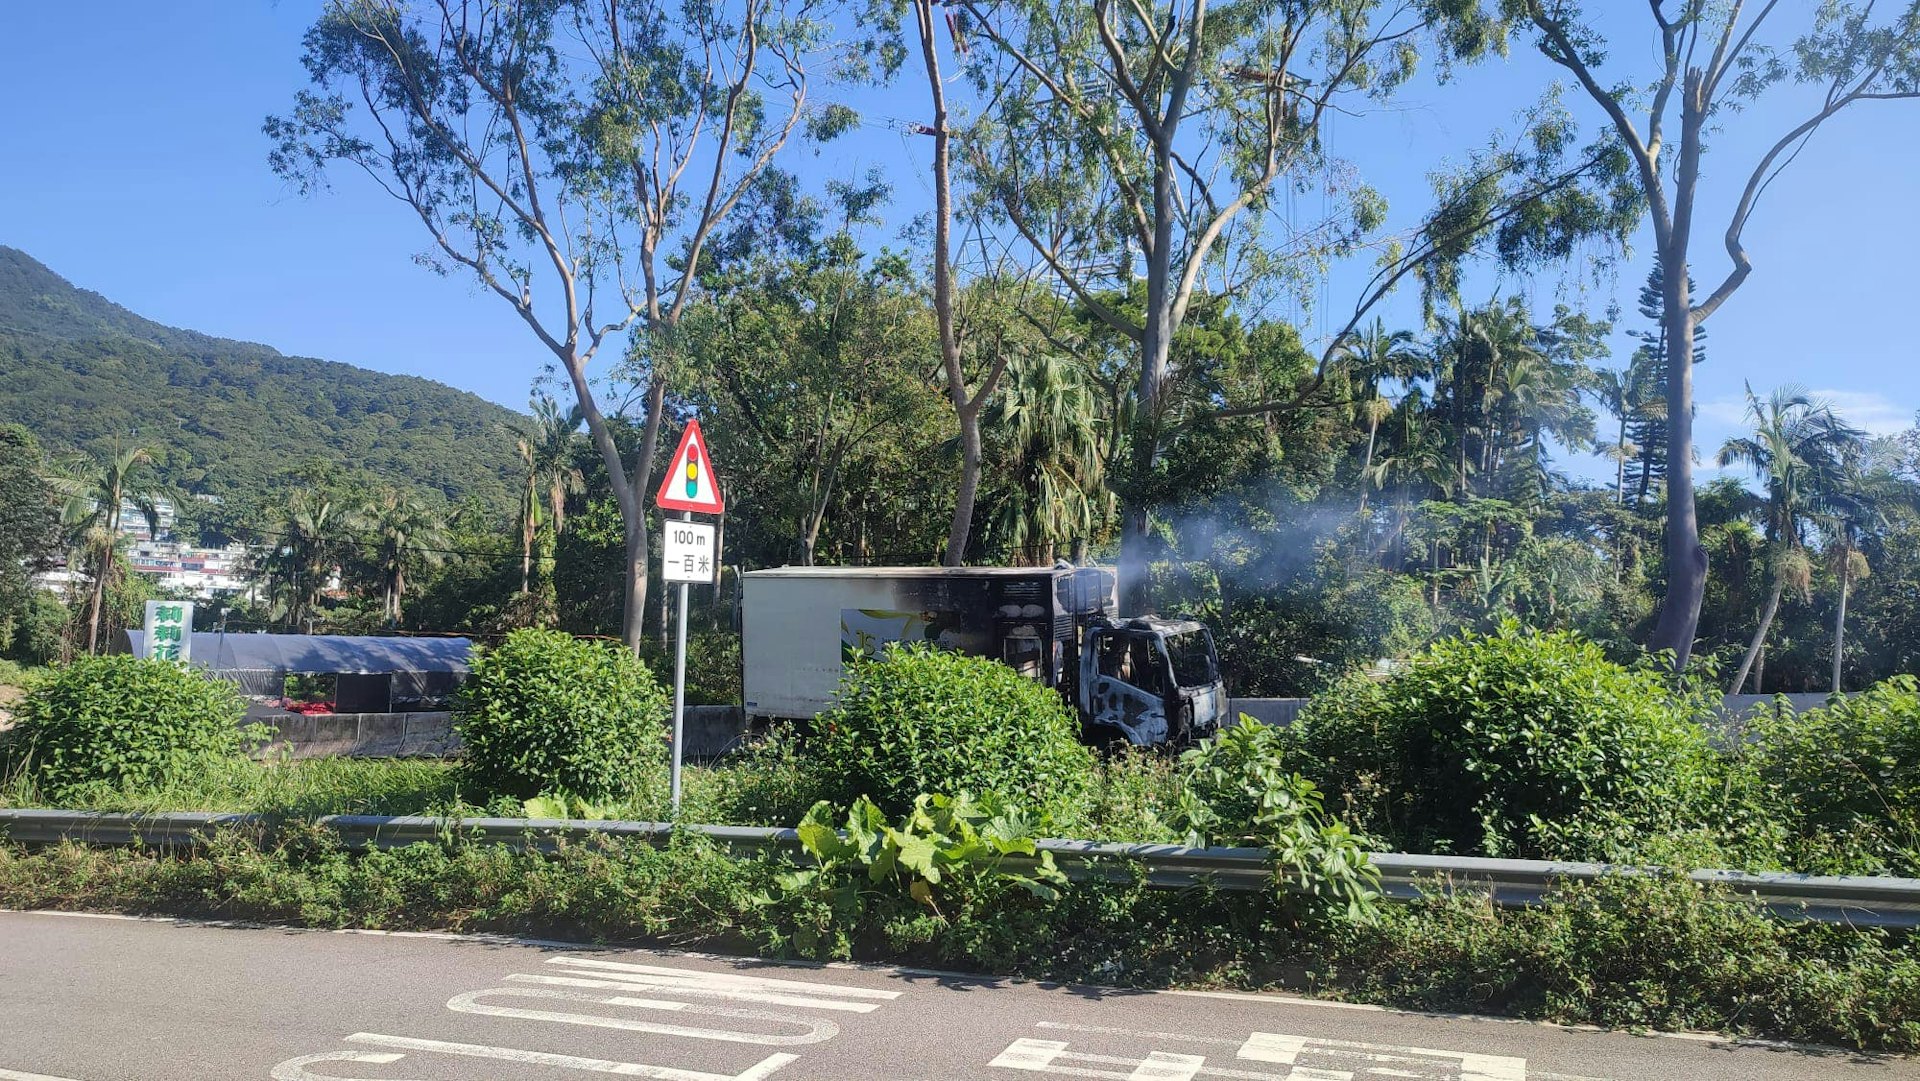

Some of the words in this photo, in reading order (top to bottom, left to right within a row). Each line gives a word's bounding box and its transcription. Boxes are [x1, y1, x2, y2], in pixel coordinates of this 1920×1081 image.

[673, 530, 694, 545] 100
[696, 535, 706, 546] m
[667, 554, 710, 574] 一百米
